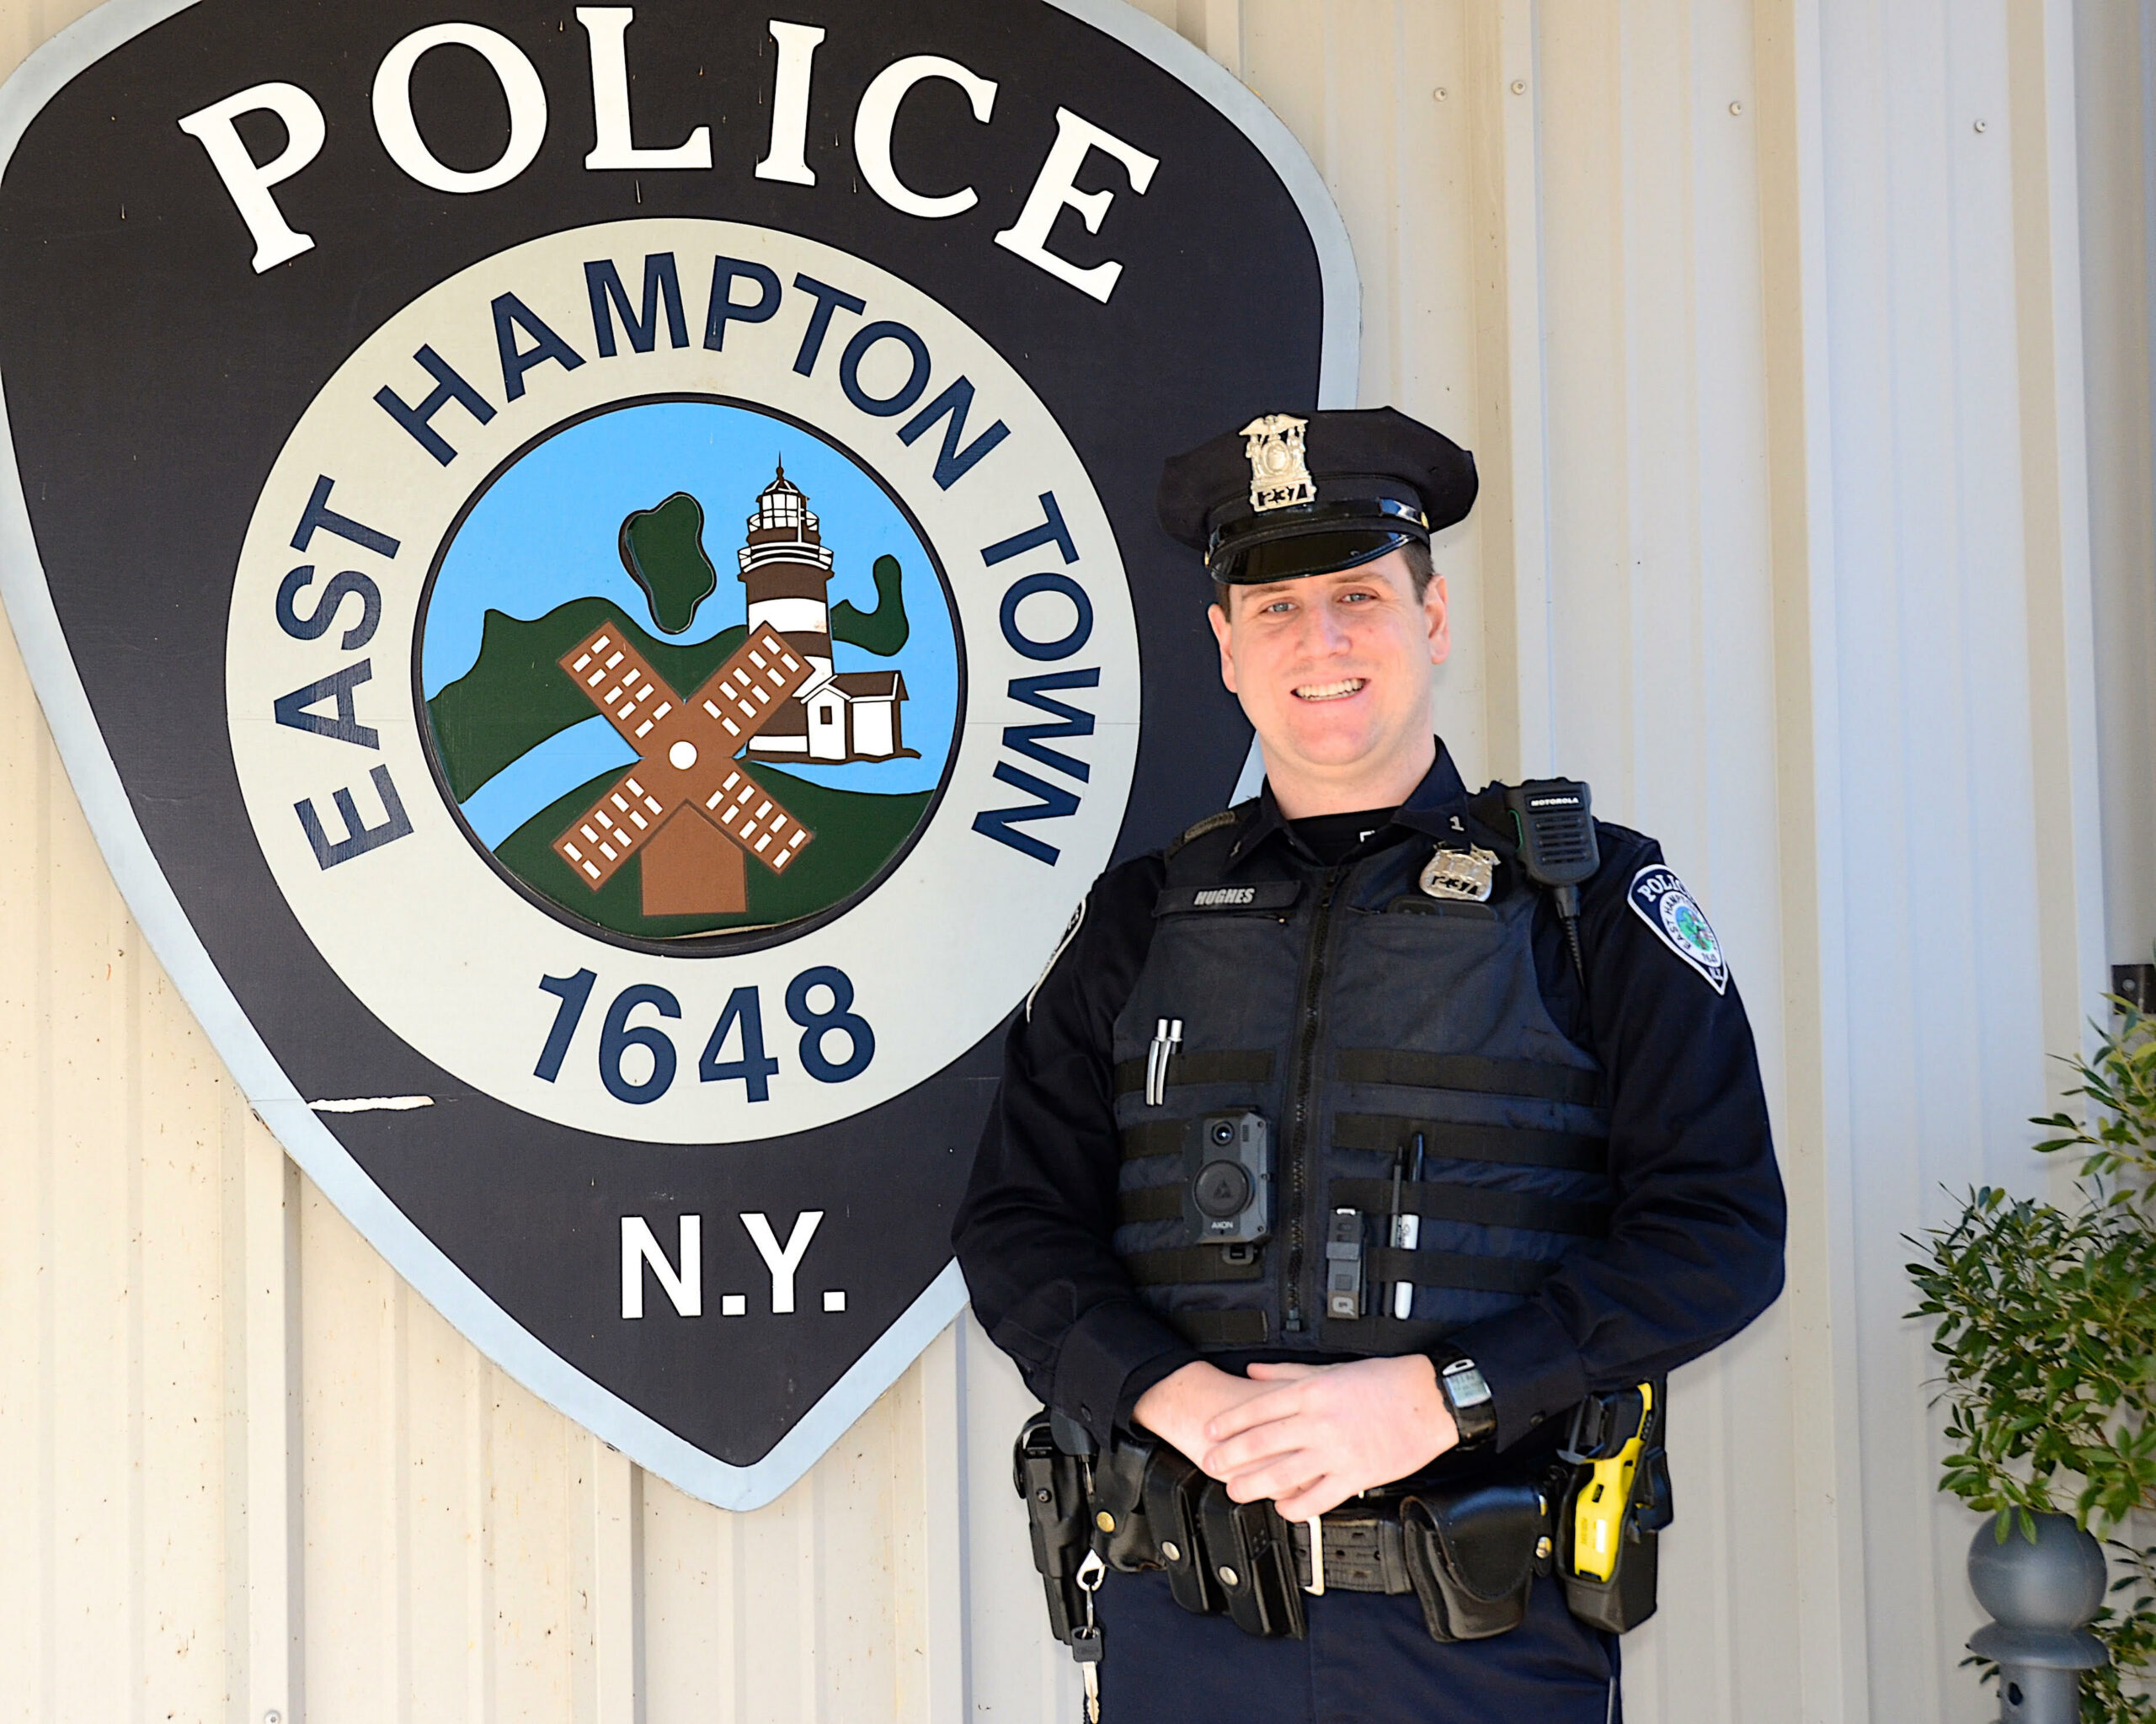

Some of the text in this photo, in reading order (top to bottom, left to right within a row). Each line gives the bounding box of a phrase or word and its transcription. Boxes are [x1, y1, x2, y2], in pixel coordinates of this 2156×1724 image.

[178, 6, 1161, 304] POLICE
[274, 251, 1102, 871] EAST HAMPTON TOWN
[1530, 797, 1580, 807] MOTOROLA
[1193, 888, 1256, 906] HUGHES
[532, 965, 876, 1105] 1648
[621, 1211, 846, 1319] N.Y.
